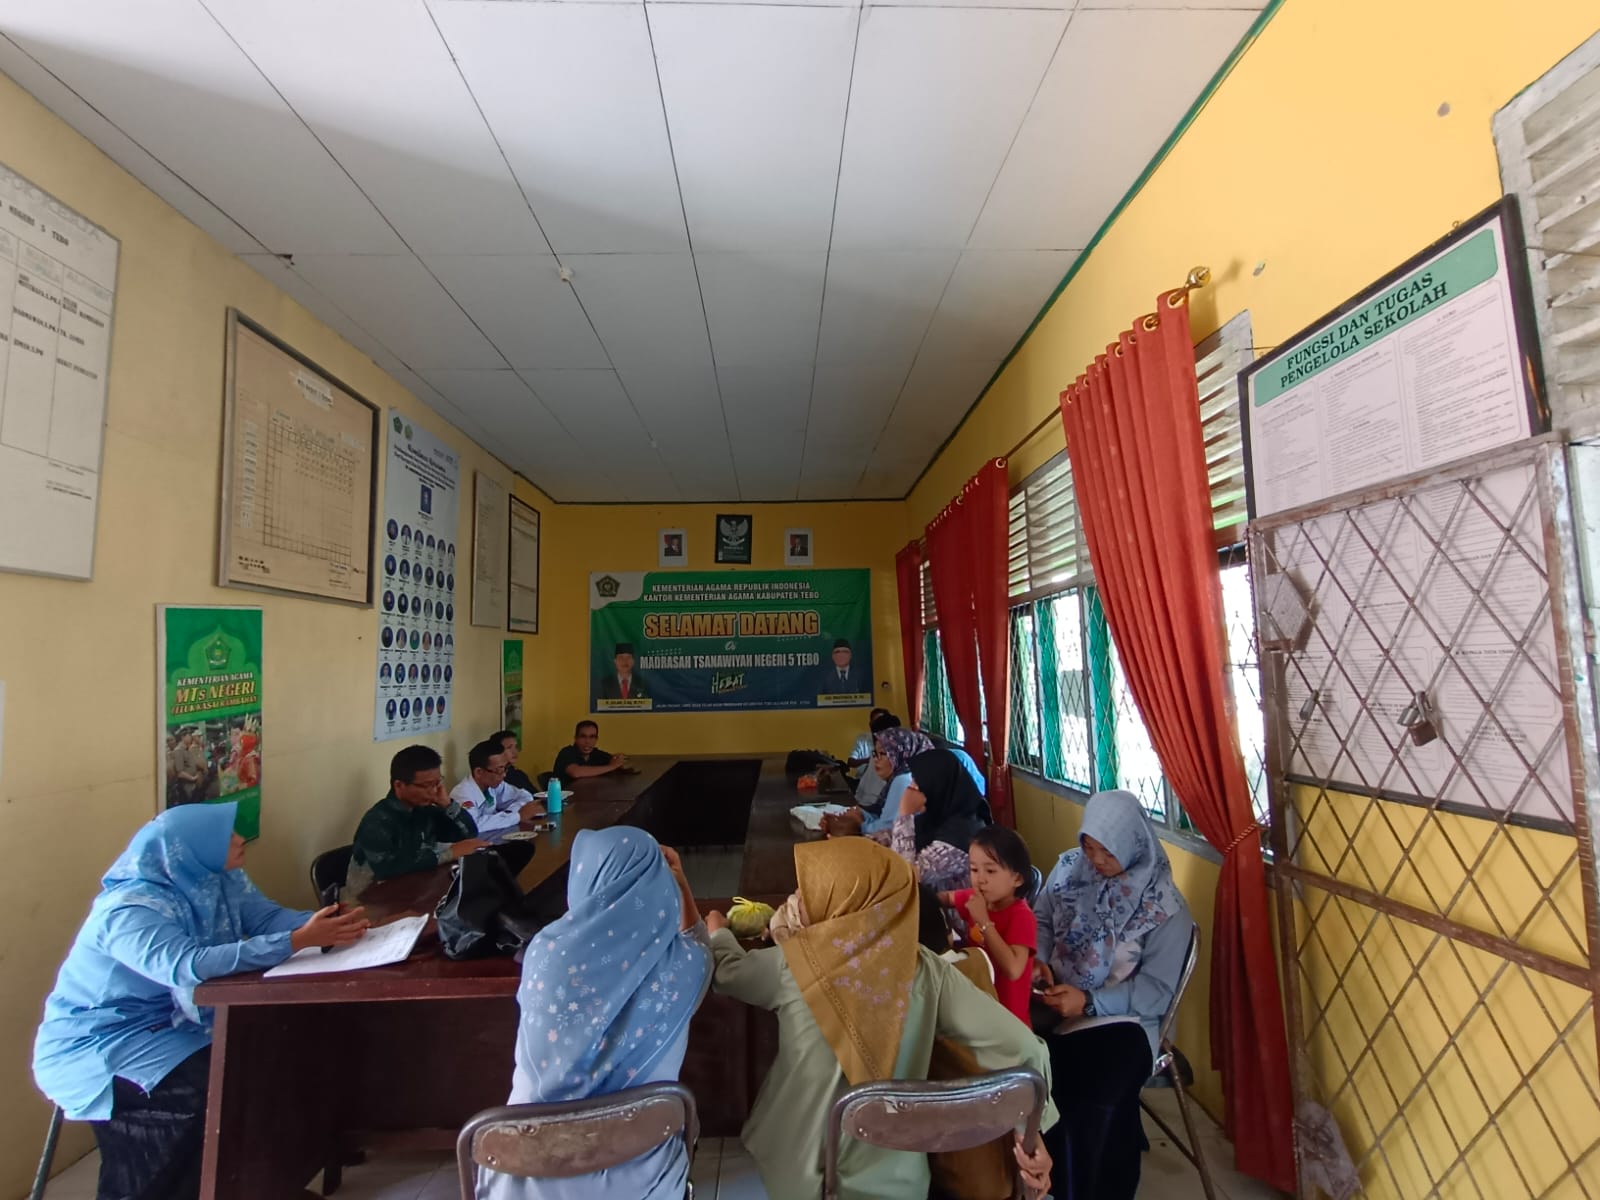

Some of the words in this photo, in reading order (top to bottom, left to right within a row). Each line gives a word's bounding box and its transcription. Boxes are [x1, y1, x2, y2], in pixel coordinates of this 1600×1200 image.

[1286, 332, 1336, 370] FUNGSI
[1338, 310, 1370, 340] DAN
[1374, 272, 1433, 316] TUGAS
[1280, 335, 1360, 388] PENGELOLA
[1364, 281, 1449, 340] SEKOLAH
[643, 593, 673, 601] KANTOR
[674, 593, 726, 601] KEMENTERIAN
[728, 592, 755, 600] AGAMA
[756, 592, 799, 600] KABUPATEN
[652, 583, 704, 592] KEMENTERIAN
[706, 583, 732, 591] AGAMA
[733, 582, 769, 591] REPUBLIK
[771, 582, 810, 590] INDONESIA
[644, 612, 737, 638] SELAMAT
[739, 611, 820, 637] DATANG
[640, 655, 691, 669] MADRASAH
[693, 654, 753, 668] TSANAWIYAH
[754, 653, 786, 667] NEGERI
[788, 653, 794, 666] 5
[796, 652, 819, 666] TEBO
[175, 687, 206, 703] MTs
[208, 681, 255, 698] NEGERI
